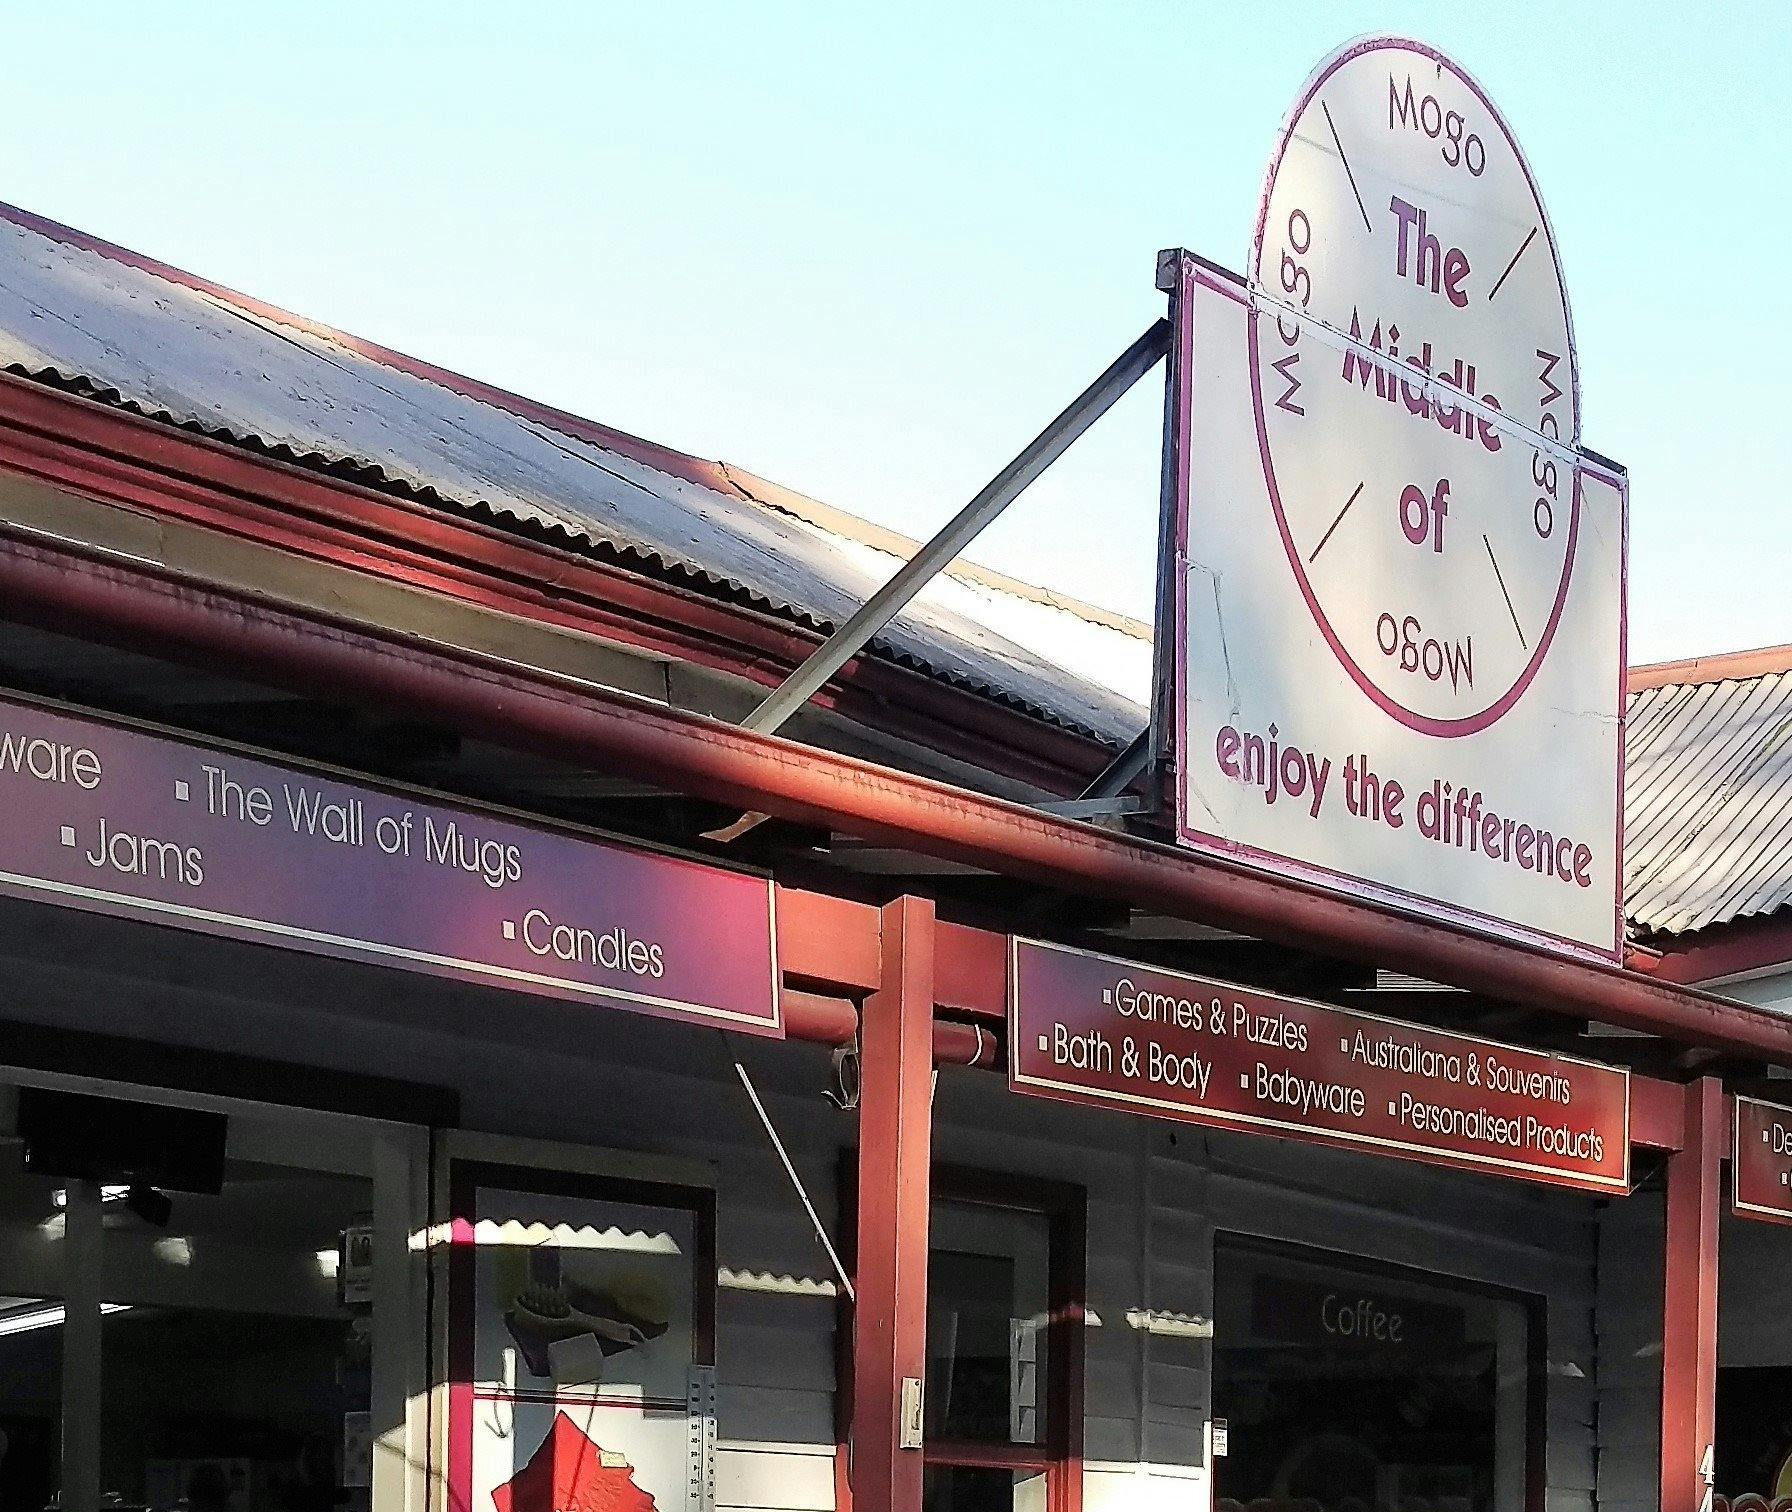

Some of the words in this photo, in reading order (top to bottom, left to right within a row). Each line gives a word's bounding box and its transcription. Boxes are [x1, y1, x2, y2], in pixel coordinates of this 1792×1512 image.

[1389, 72, 1486, 177] Mogo
[1271, 208, 1310, 416] Mogo
[1389, 195, 1471, 308] The
[1341, 305, 1502, 452] Middle
[1532, 348, 1563, 539] Mogo
[1399, 478, 1451, 554] of
[1376, 612, 1474, 696] Mogo
[202, 765, 273, 826] The
[284, 783, 365, 847] Wall
[375, 811, 414, 858] of
[424, 815, 523, 888] Mugs
[1216, 722, 1331, 818] enjoy
[1343, 754, 1405, 828] the
[1416, 779, 1594, 888] difference
[86, 817, 205, 887] Jams
[522, 908, 666, 979] Candles
[1053, 1022, 1113, 1074] Bath
[1120, 1036, 1141, 1078] &
[1148, 1041, 1212, 1100] Body
[1256, 1062, 1365, 1117] Babyware
[1400, 1092, 1522, 1148] Personalised
[1526, 1115, 1604, 1162] Products
[1115, 978, 1203, 1032] Games
[1209, 997, 1227, 1036] &
[1232, 1002, 1308, 1052] Puzzles
[1351, 1029, 1461, 1083] Australiana
[1466, 1052, 1482, 1087] &
[1486, 1056, 1571, 1105] Souvenirs
[1320, 1294, 1403, 1343] Coffee
